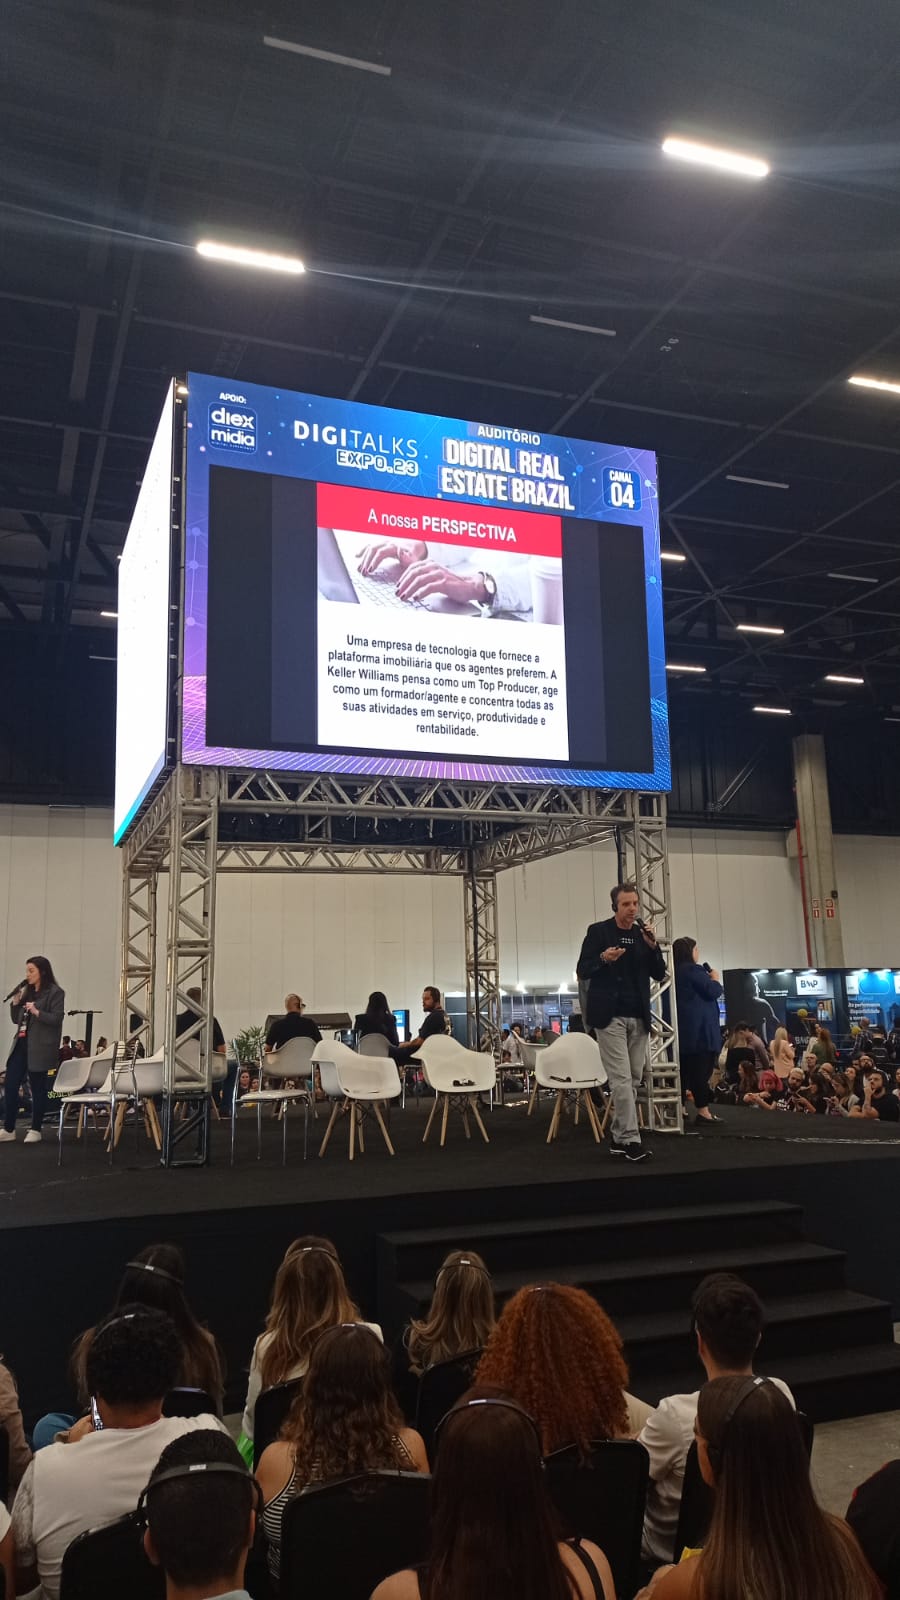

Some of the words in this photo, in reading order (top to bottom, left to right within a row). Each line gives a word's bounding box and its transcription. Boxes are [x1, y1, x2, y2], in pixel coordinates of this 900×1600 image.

[219, 392, 247, 404] APOIO:
[211, 429, 255, 446] midia
[294, 420, 418, 457] DIGITALKS
[478, 425, 540, 446] AUDITÓRIO
[336, 448, 419, 476] EXPO.23
[445, 438, 515, 473] DIGITAL
[518, 449, 565, 481] REAL
[441, 467, 508, 501] ESTATE
[512, 478, 575, 511] BRAZIL
[609, 470, 634, 484] CANAL
[610, 482, 635, 508] 04
[368, 508, 378, 523] A
[381, 513, 419, 529] nossa
[422, 515, 517, 542] PERSPECTIVA
[347, 634, 369, 647] Uma
[371, 639, 412, 651] empresa
[415, 641, 426, 653] de
[429, 643, 477, 659] tecnologia
[480, 649, 496, 660] que
[499, 649, 532, 662] fornece
[534, 655, 540, 663] a
[328, 649, 380, 664] plataforma
[383, 654, 432, 669] imobiliária
[435, 661, 452, 672] que
[455, 663, 466, 672] os
[468, 664, 504, 676] agentes
[507, 667, 549, 679] preferem.
[550, 669, 557, 679] A
[328, 665, 356, 678] Keller
[358, 668, 399, 682] Williams
[402, 674, 431, 685] pensa
[433, 677, 459, 687] como
[462, 681, 476, 689] um
[479, 679, 495, 692] Top
[498, 681, 540, 695] Producer,
[542, 686, 558, 698] age
[333, 685, 360, 695] como
[363, 687, 378, 696] um
[381, 686, 459, 704] formador/agente
[461, 696, 466, 704] e
[469, 696, 514, 707] concentra
[516, 699, 541, 710] todas
[544, 702, 554, 711] as
[342, 702, 366, 712] suas
[369, 702, 418, 716] atividades
[421, 708, 435, 717] em
[437, 709, 474, 722] serviço,
[477, 712, 538, 725] produtividade
[541, 717, 546, 725] e
[416, 723, 479, 736] rentabilidade.
